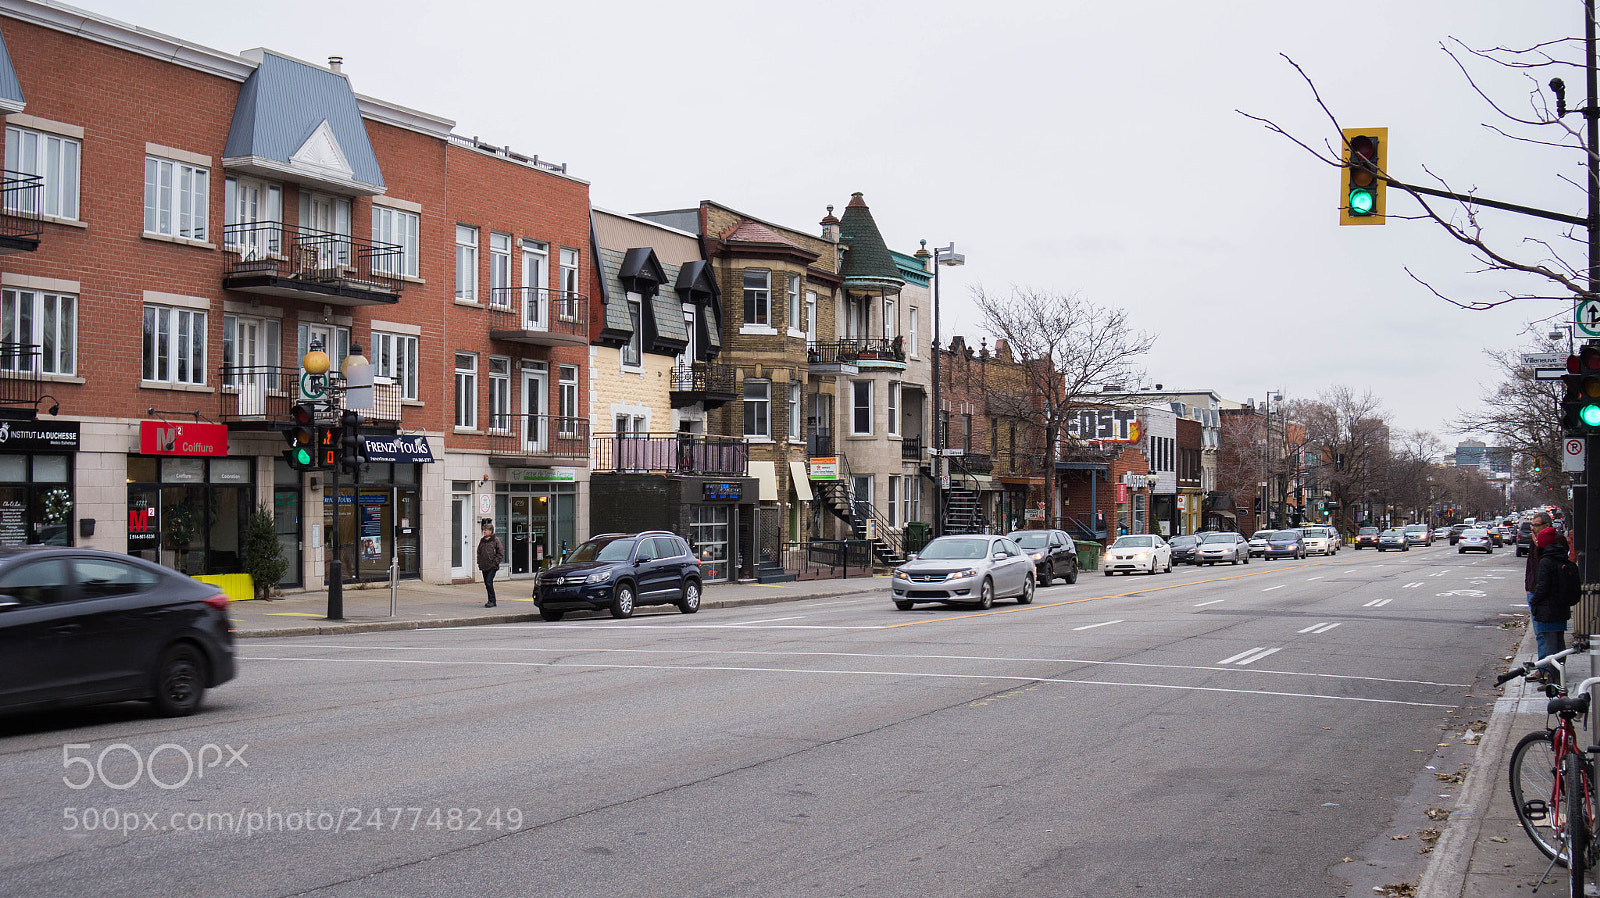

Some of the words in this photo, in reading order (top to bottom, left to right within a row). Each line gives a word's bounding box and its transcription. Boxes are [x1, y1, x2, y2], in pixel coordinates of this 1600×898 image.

[11, 431, 37, 439] INSTITUT
[37, 431, 46, 440] LA
[46, 432, 77, 440] DUCHESSE
[182, 442, 214, 453] Coiffure
[365, 440, 398, 453] FRENZY
[400, 441, 428, 454] TOURS
